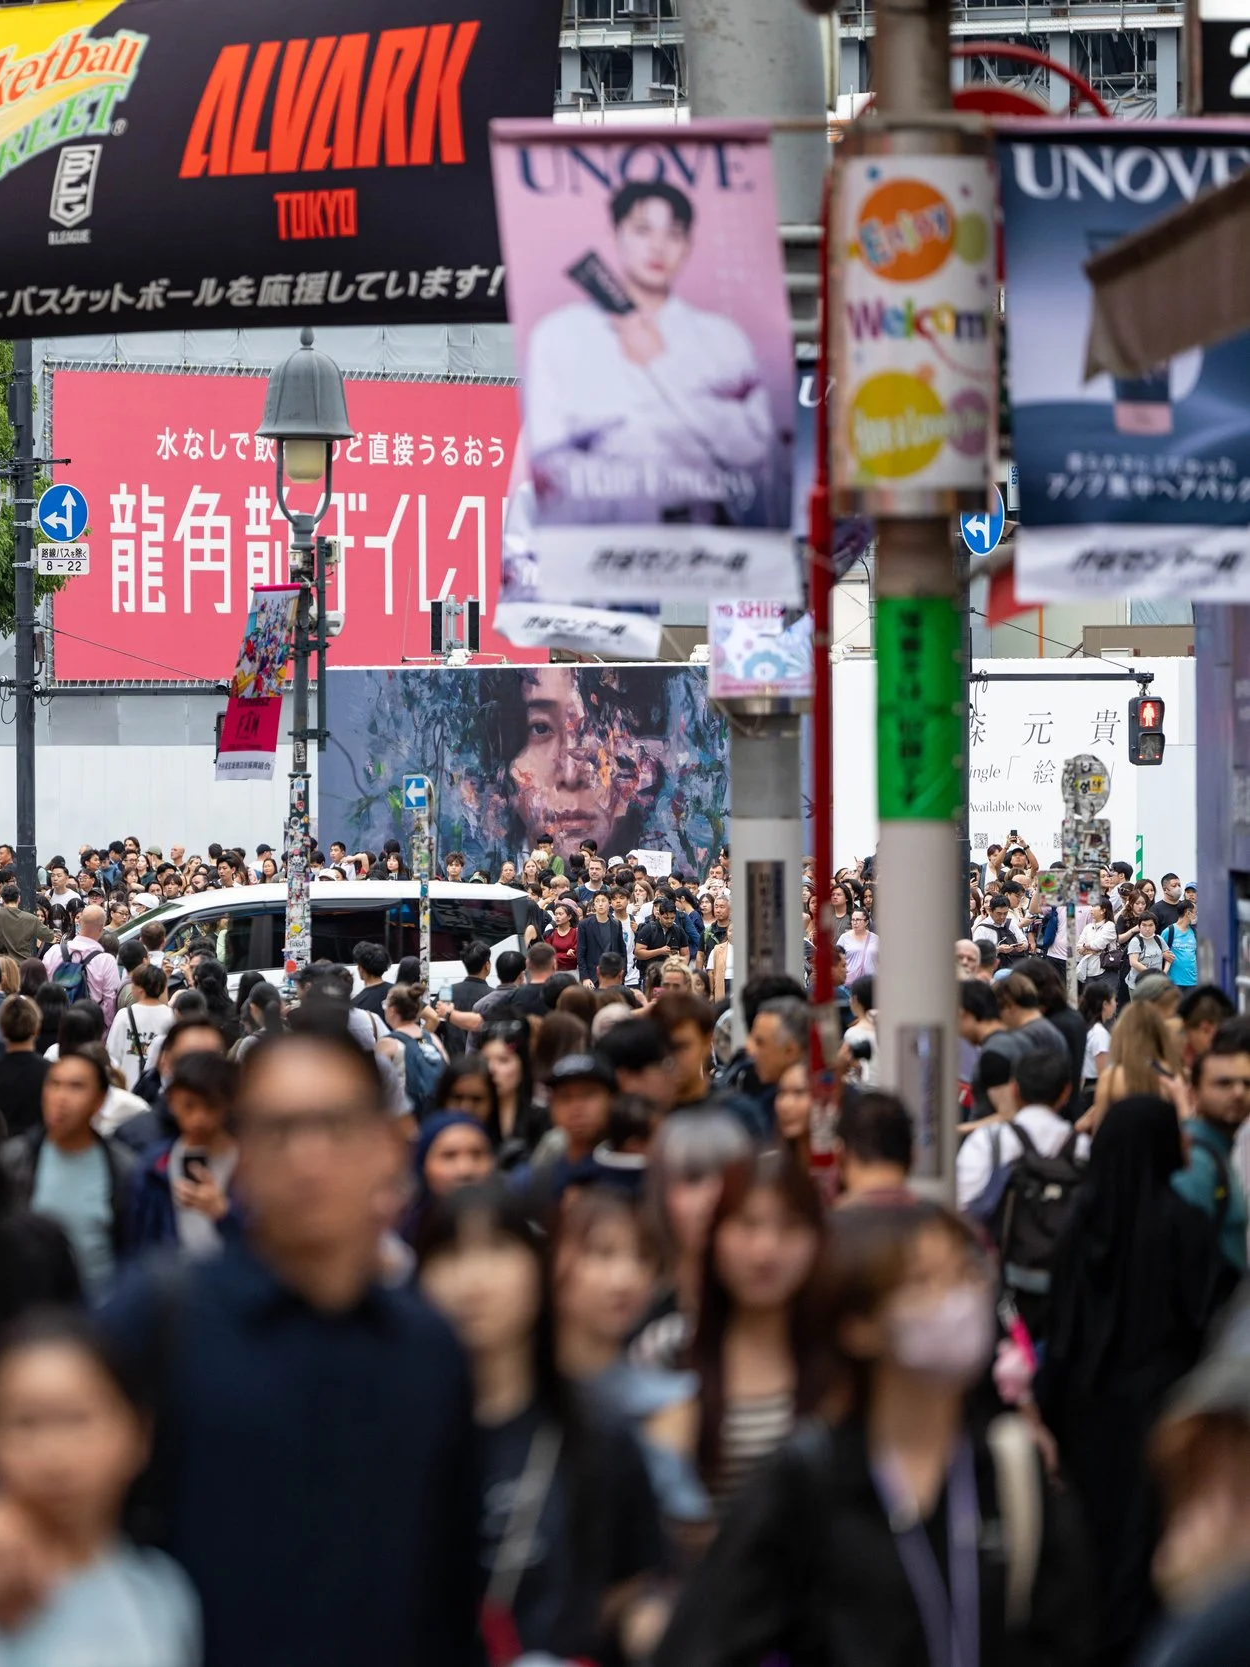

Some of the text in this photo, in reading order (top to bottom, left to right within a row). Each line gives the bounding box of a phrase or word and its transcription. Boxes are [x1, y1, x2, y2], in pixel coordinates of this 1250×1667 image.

[178, 20, 481, 179] ALVARK
[273, 188, 358, 241] TOKYO
[847, 296, 990, 341] Welcom
[41, 547, 87, 558] 路線バスを除く
[109, 483, 509, 616] 龍角散ダイレク
[969, 800, 1043, 813] Available Now
